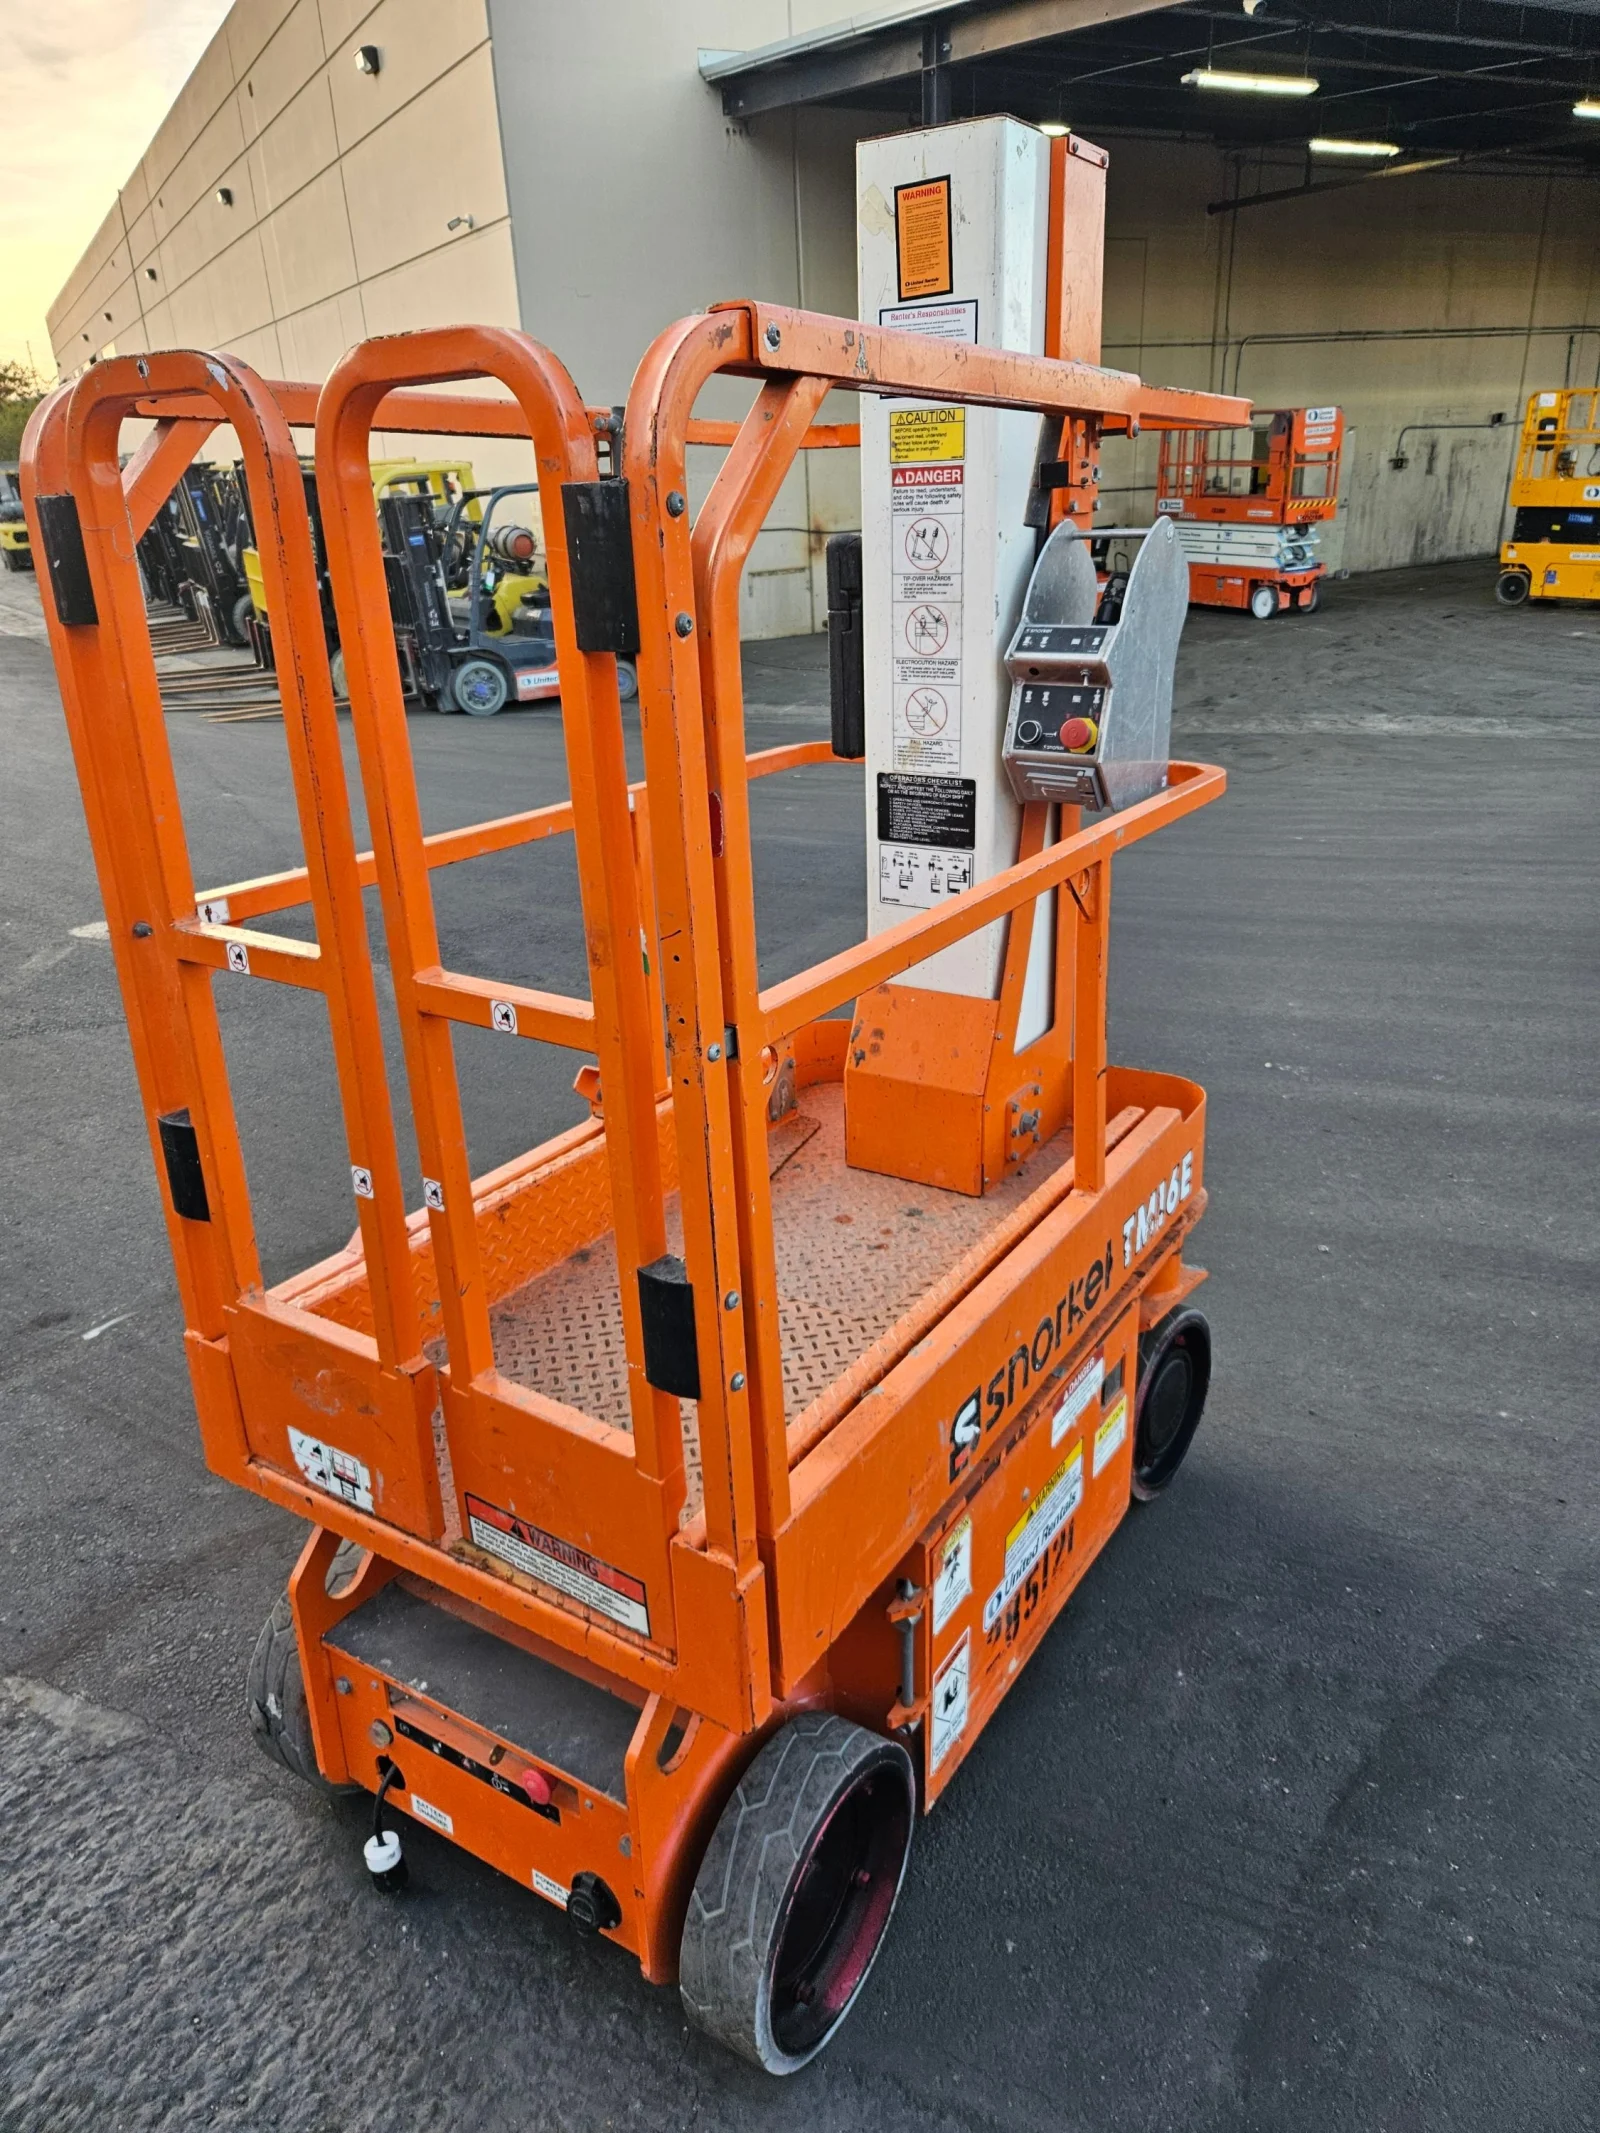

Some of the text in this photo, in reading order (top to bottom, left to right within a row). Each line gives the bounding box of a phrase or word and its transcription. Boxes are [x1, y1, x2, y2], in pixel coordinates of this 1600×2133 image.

[903, 186, 941, 201] WARNING
[891, 307, 966, 320] Renter's Responsibilities
[906, 410, 955, 424] CAUTION
[906, 469, 961, 484] DANGER
[1123, 1150, 1193, 1269] TM16E
[986, 1239, 1113, 1434] snorkel
[1069, 1356, 1095, 1392] DANGER
[1035, 1461, 1066, 1509] WARNING
[528, 1526, 598, 1578] WARNING
[1004, 1491, 1076, 1596] United Rentals
[416, 1799, 447, 1821] BATTERY
[536, 1873, 563, 1893] POWER
[536, 1880, 568, 1902] PLATFO
